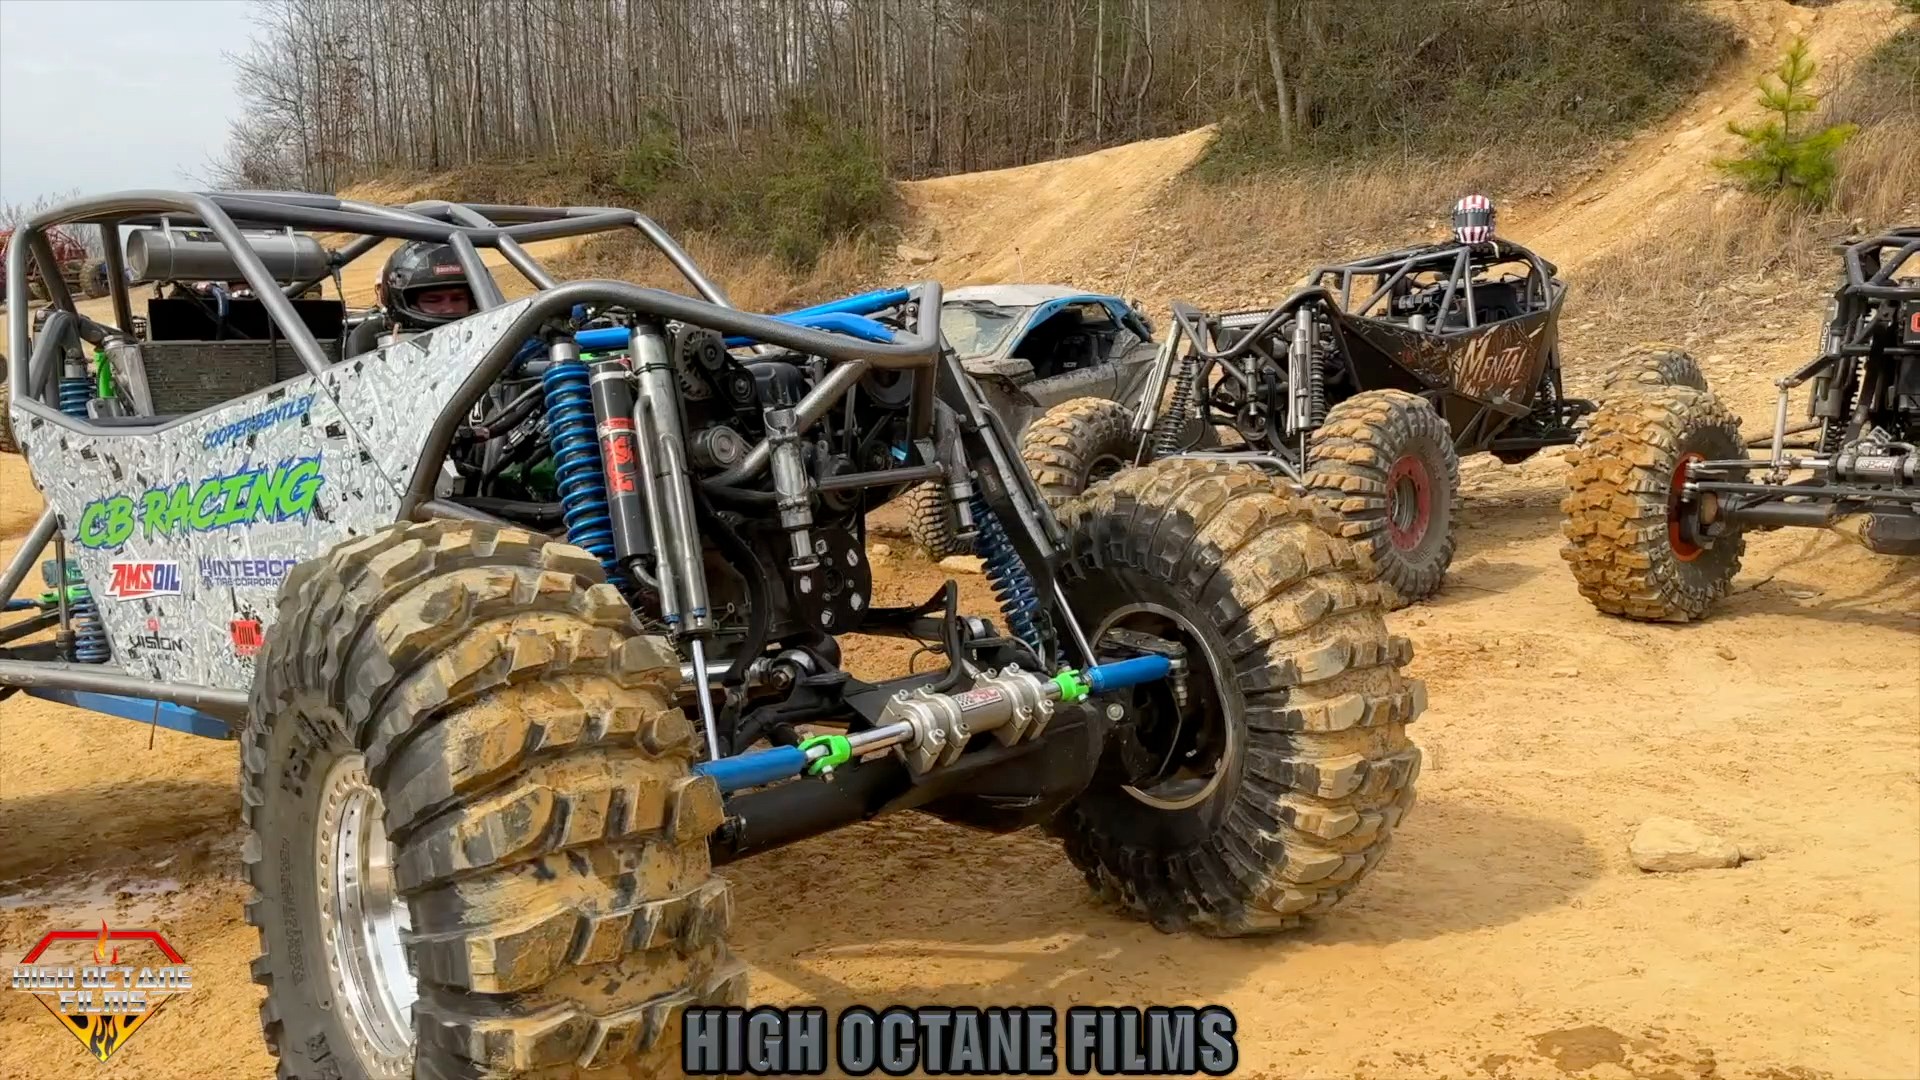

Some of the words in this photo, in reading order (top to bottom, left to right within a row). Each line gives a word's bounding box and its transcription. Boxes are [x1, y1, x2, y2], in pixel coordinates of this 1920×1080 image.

[73, 495, 136, 549] CB
[139, 456, 325, 543] RACING
[109, 563, 180, 597] AMSOIL
[128, 631, 182, 652] VISION
